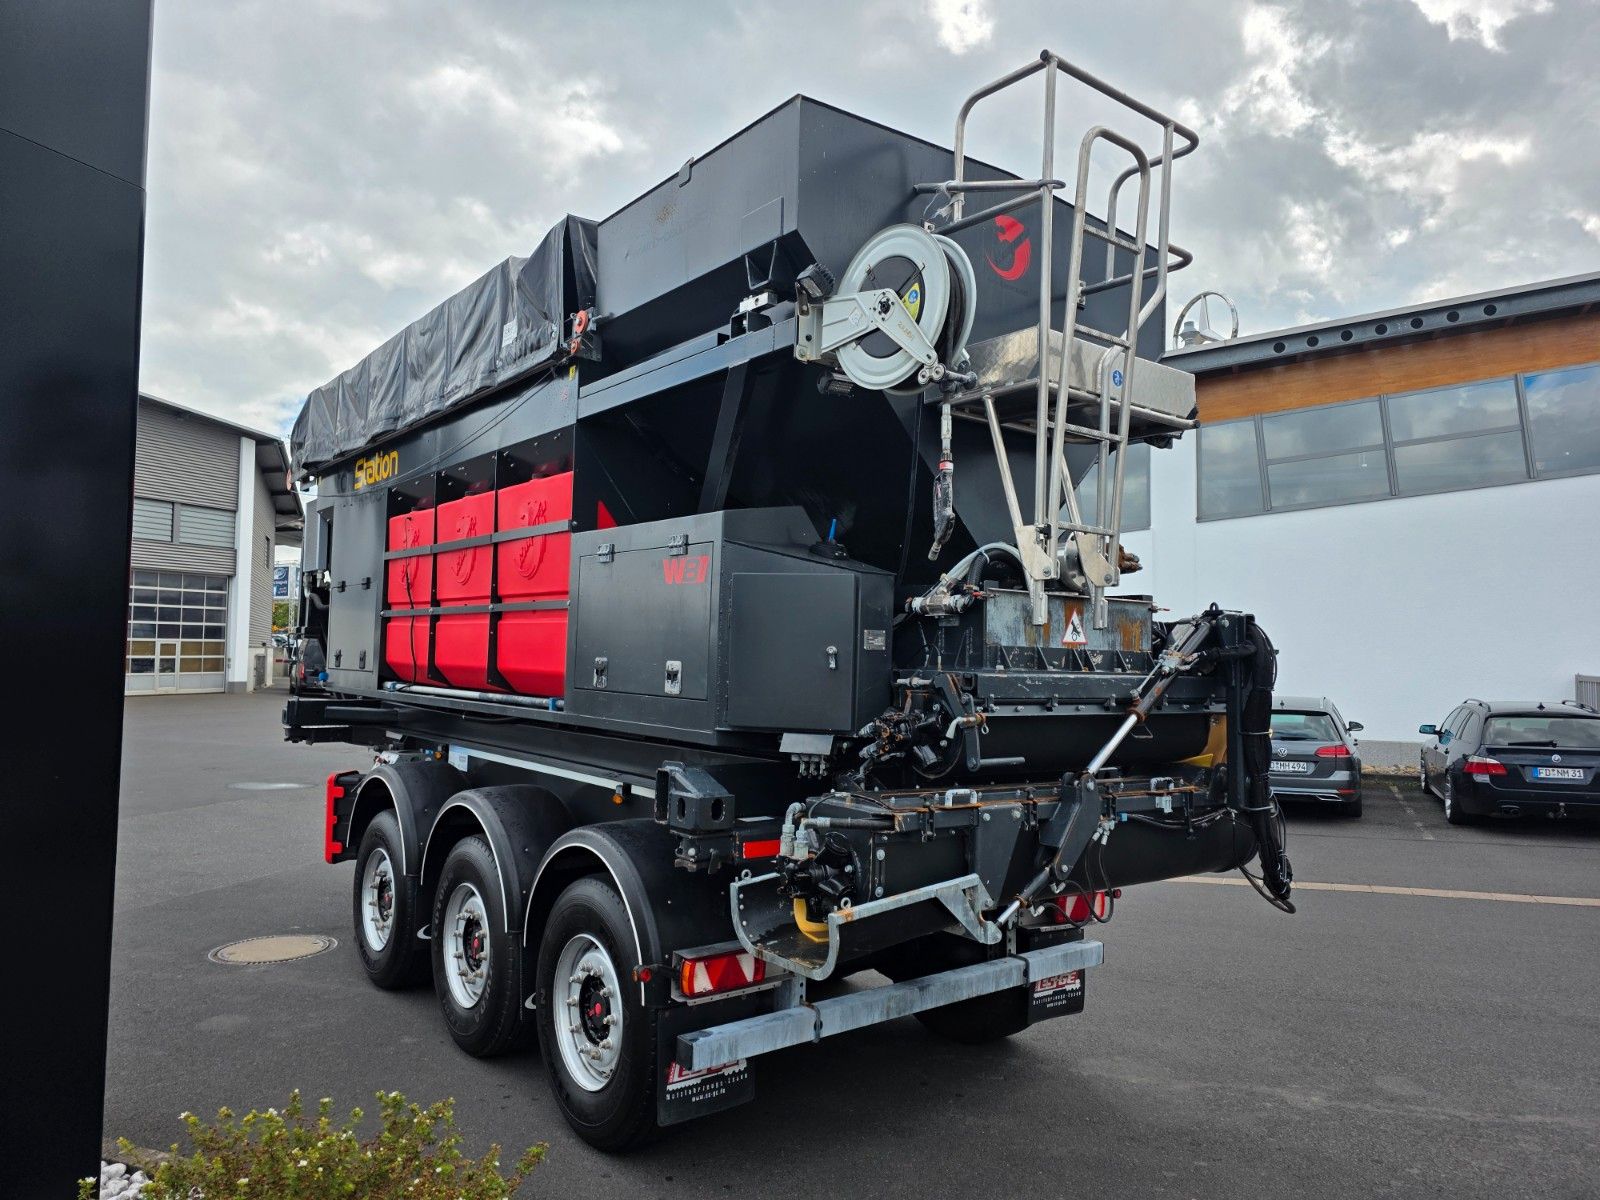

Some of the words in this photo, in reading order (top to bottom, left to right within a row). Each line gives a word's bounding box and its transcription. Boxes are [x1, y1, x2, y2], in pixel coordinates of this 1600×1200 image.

[354, 450, 399, 490] Station
[1291, 762, 1306, 770] 494
[1539, 768, 1550, 776] FD
[1571, 769, 1583, 777] 31
